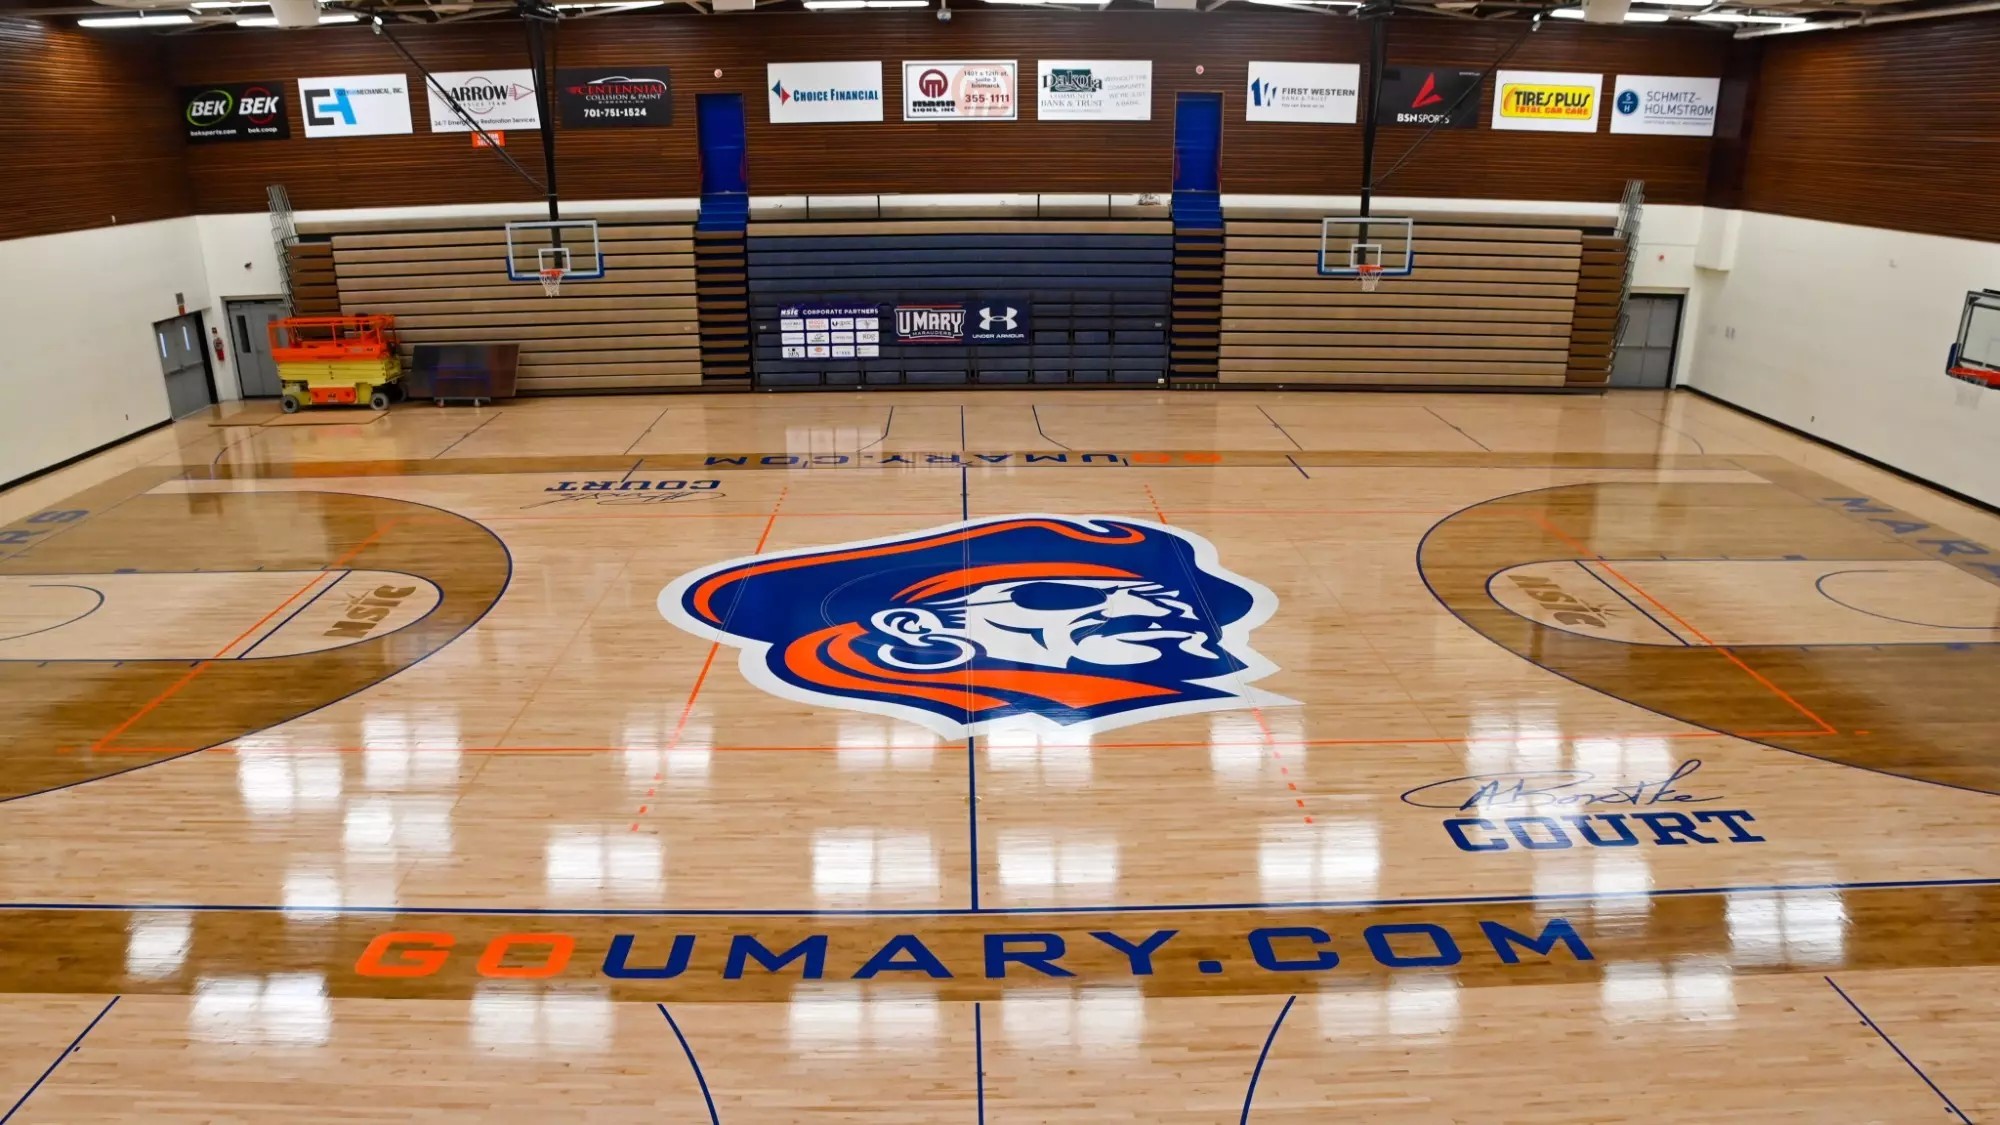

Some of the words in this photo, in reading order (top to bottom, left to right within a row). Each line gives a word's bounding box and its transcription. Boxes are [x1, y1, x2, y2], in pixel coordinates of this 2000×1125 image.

[1042, 70, 1103, 90] Dakota
[450, 85, 509, 102] ARROW
[577, 83, 664, 95] CENTENNIAL
[793, 89, 828, 102] CHOICE
[830, 88, 879, 102] FINANCIAL
[1282, 87, 1309, 95] FIRST
[1311, 88, 1356, 97] WESTERN
[1515, 91, 1553, 106] TIRES
[1555, 93, 1591, 107] PLUS
[1647, 91, 1702, 103] SCHMITZ-
[191, 100, 227, 117] BEK
[239, 96, 279, 115] BEK
[1515, 106, 1542, 114] TOTAL
[1544, 107, 1563, 115] CAR
[1565, 108, 1590, 116] CARE
[1644, 104, 1715, 115] HOLMSTROM
[1397, 113, 1418, 122] BSN
[544, 480, 721, 492] COURT
[1507, 575, 1607, 629] NSIC
[323, 585, 417, 639] NSIC
[1442, 809, 1766, 852] COURT
